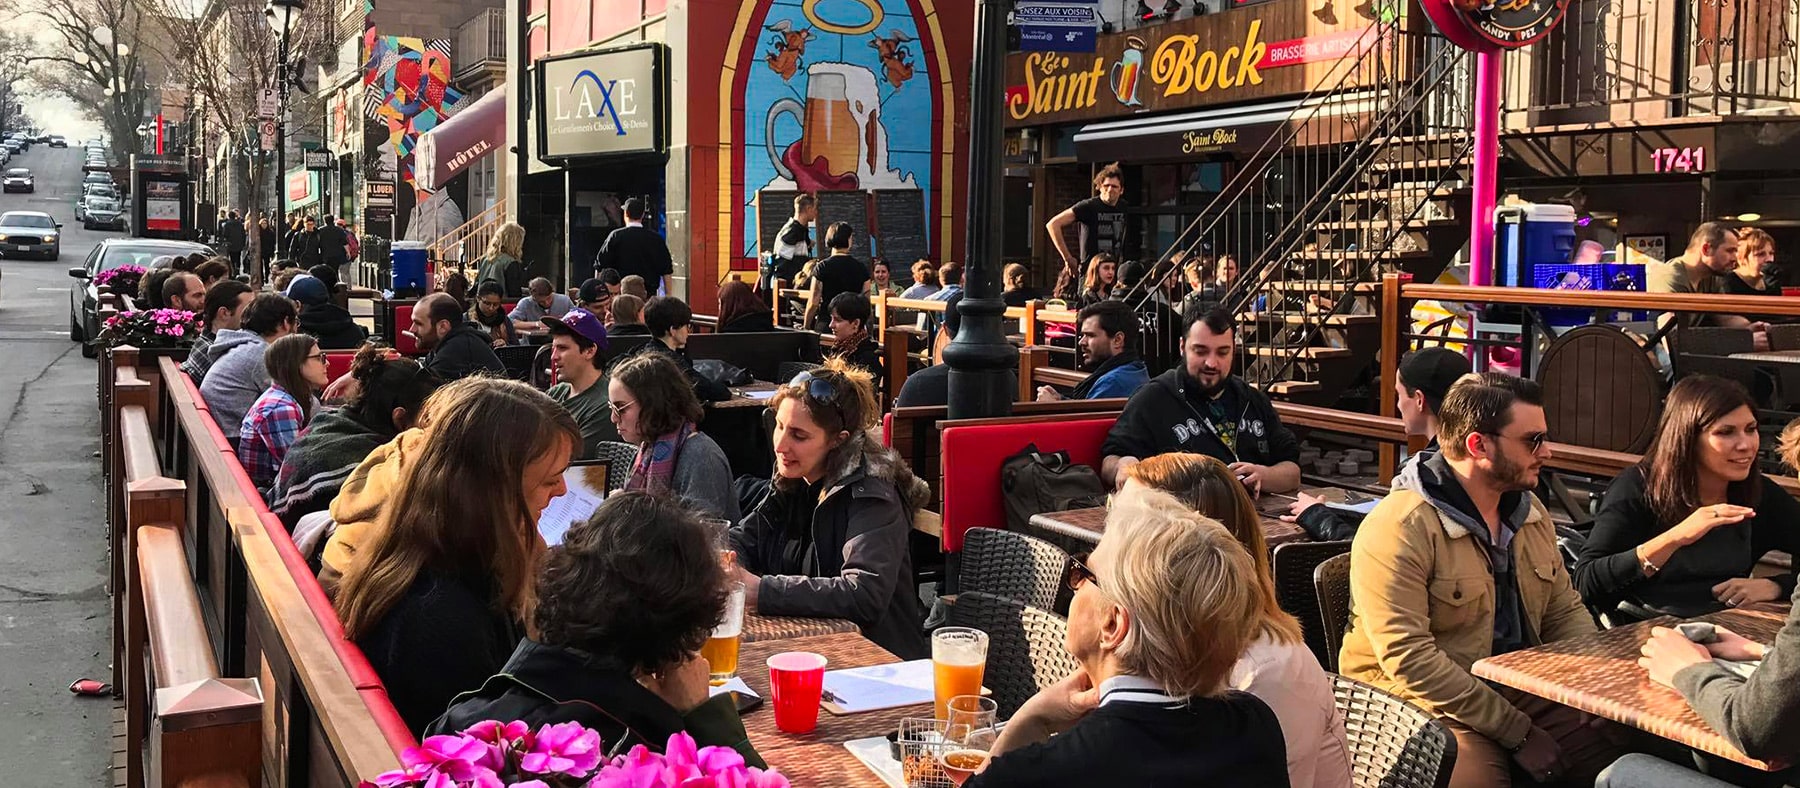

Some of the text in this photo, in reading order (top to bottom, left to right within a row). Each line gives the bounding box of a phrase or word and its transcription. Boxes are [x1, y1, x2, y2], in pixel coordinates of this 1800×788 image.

[1062, 8, 1092, 16] VOISINS
[1480, 21, 1510, 40] CANDY
[1271, 43, 1320, 62] BRASSERIE
[1010, 19, 1266, 120] Saint Bock
[264, 90, 272, 100] P
[1182, 128, 1237, 153] Saint Bock
[446, 140, 492, 171] HÔTEL
[1650, 146, 1704, 172] 1741
[373, 184, 394, 194] LOUER
